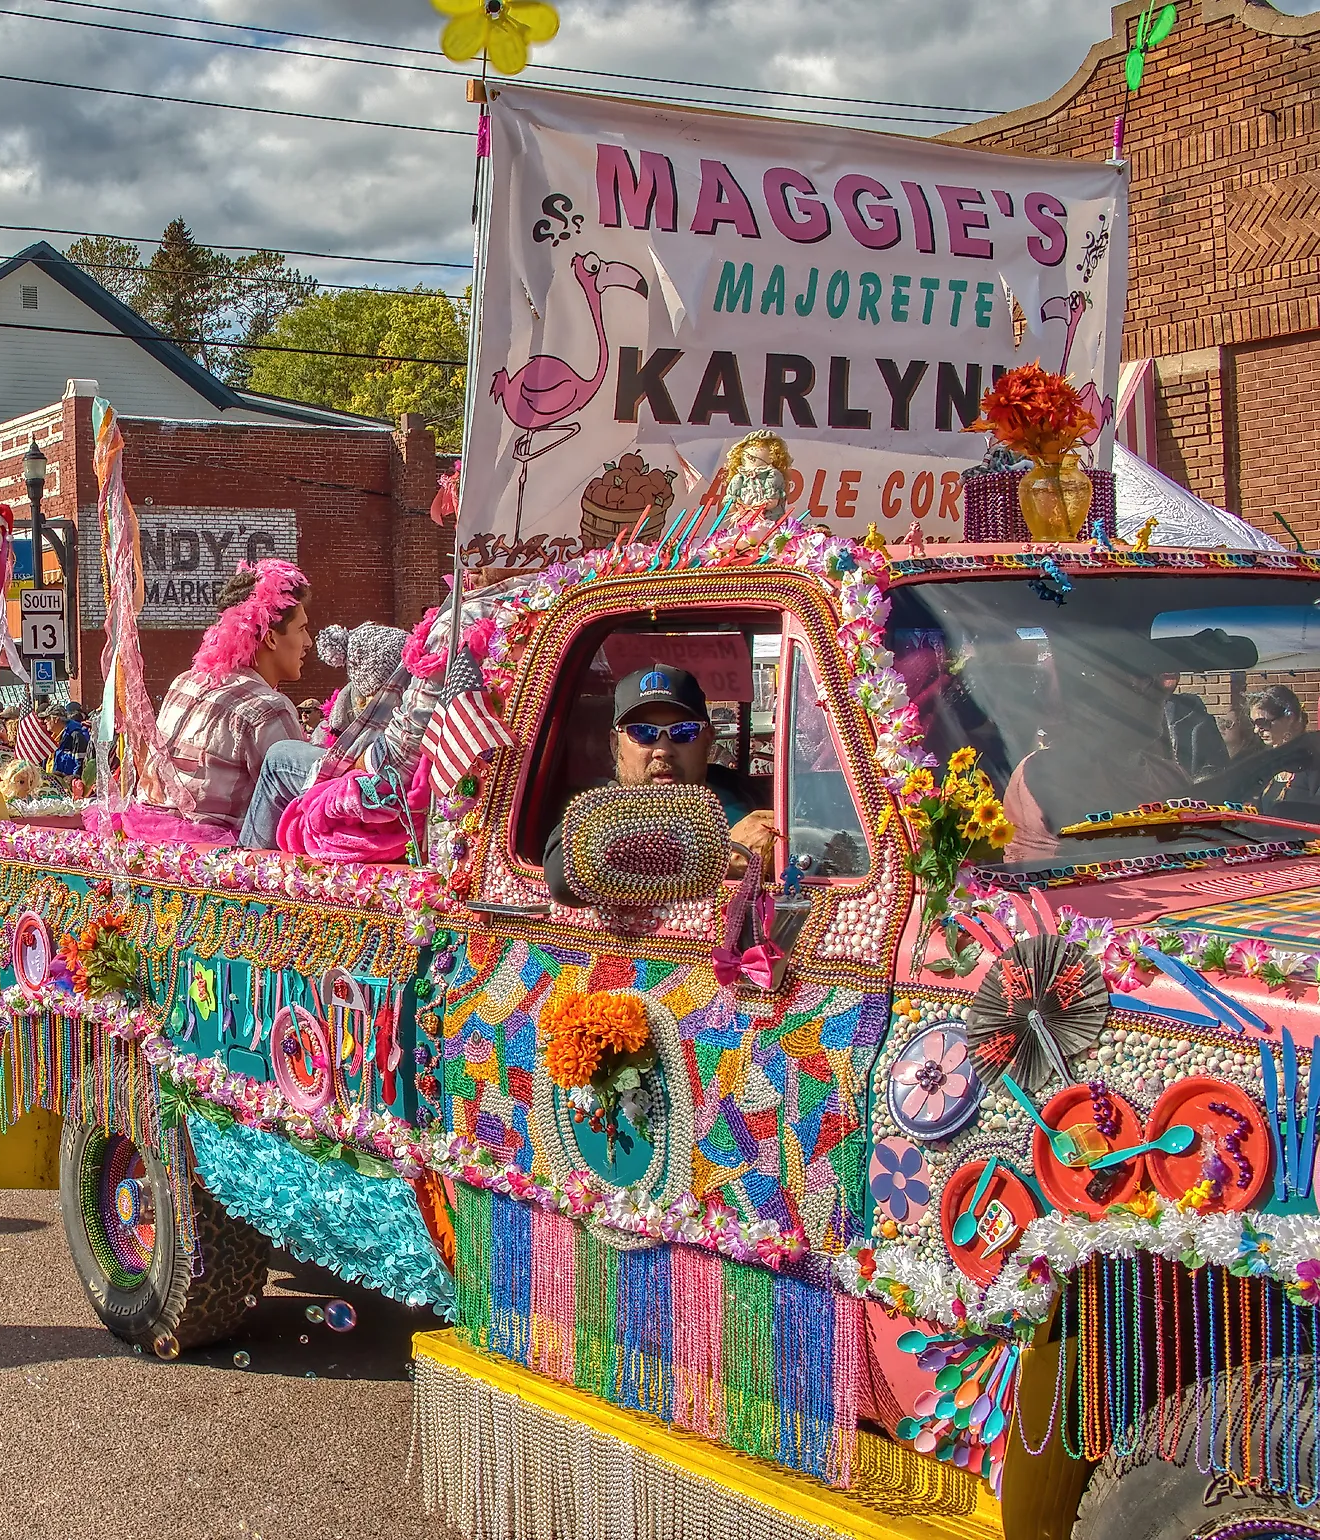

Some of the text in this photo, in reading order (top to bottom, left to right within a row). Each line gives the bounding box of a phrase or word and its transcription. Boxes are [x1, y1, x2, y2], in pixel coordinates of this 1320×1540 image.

[595, 143, 1068, 267] MAGGIE'S
[713, 260, 995, 328] MAJORETTE
[700, 468, 963, 522] APLE COR
[24, 594, 61, 608] SOUTH
[144, 580, 225, 605] MARKE
[31, 624, 57, 649] 13
[639, 690, 672, 698] MOPAR
